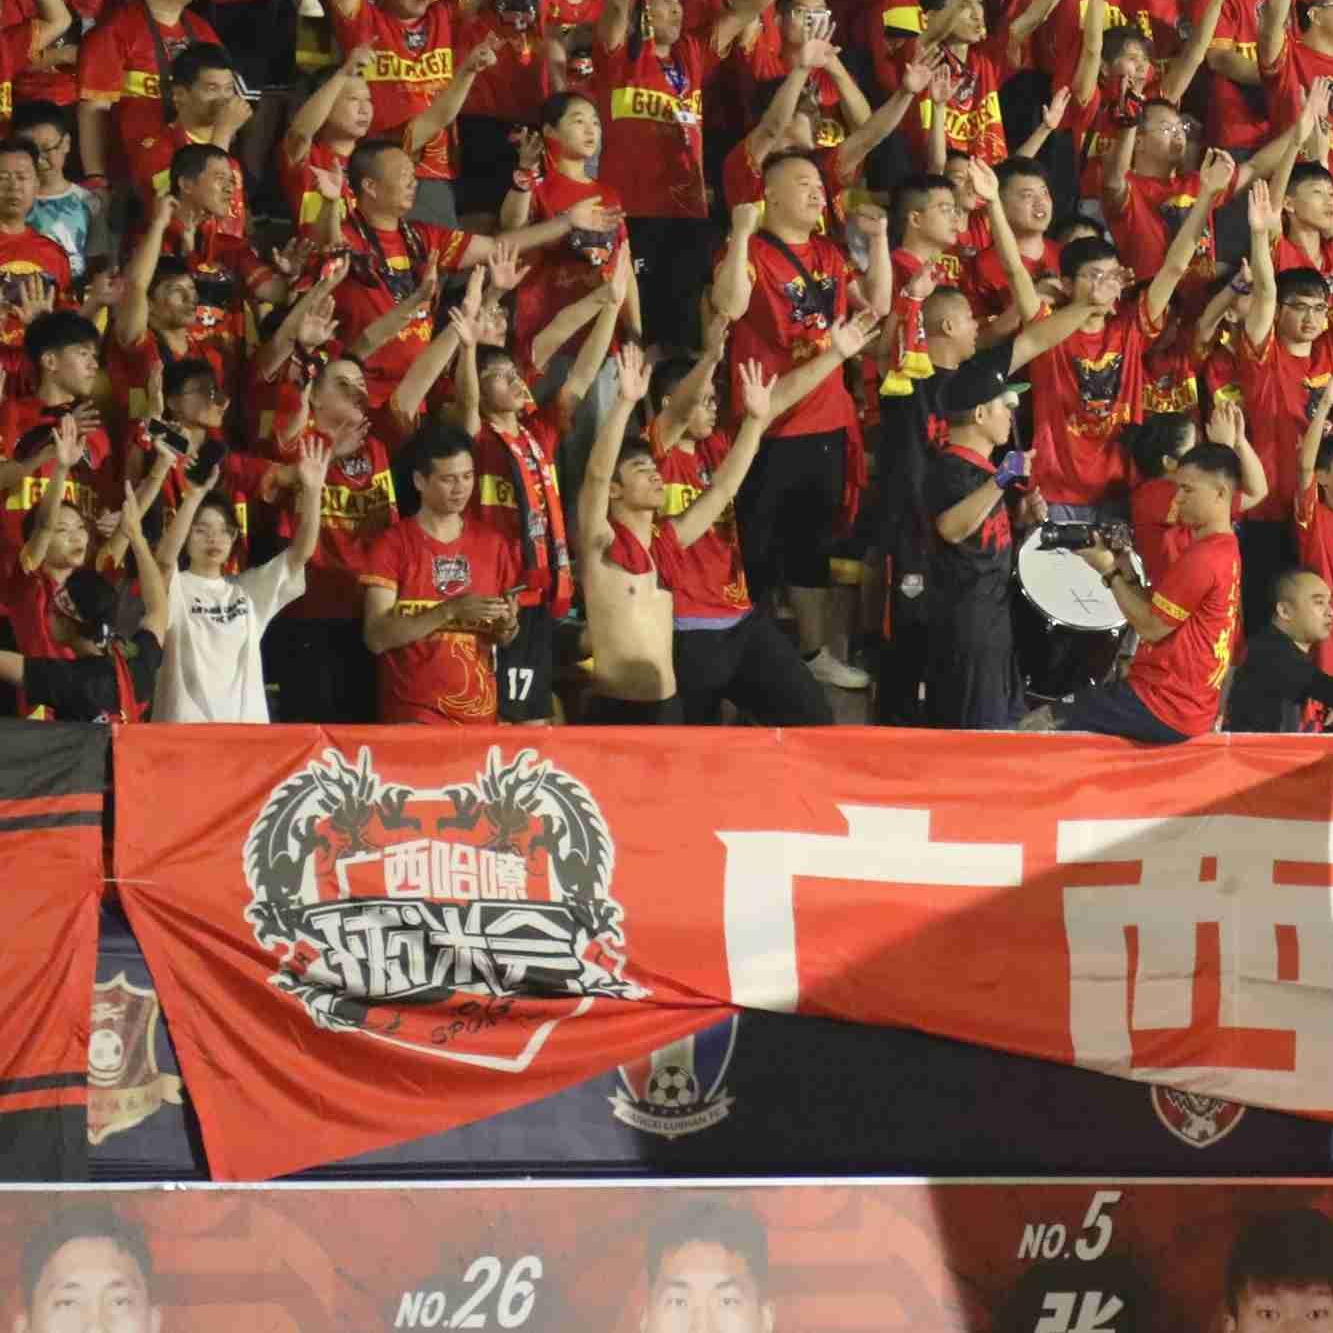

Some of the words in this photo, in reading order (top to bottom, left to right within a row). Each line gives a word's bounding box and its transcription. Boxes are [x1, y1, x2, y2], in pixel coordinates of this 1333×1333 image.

[508, 667, 534, 701] 17
[335, 838, 528, 900] 广西哈嘹
[1017, 1190, 1123, 1261] NO.5
[394, 1255, 544, 1330] NO.26
